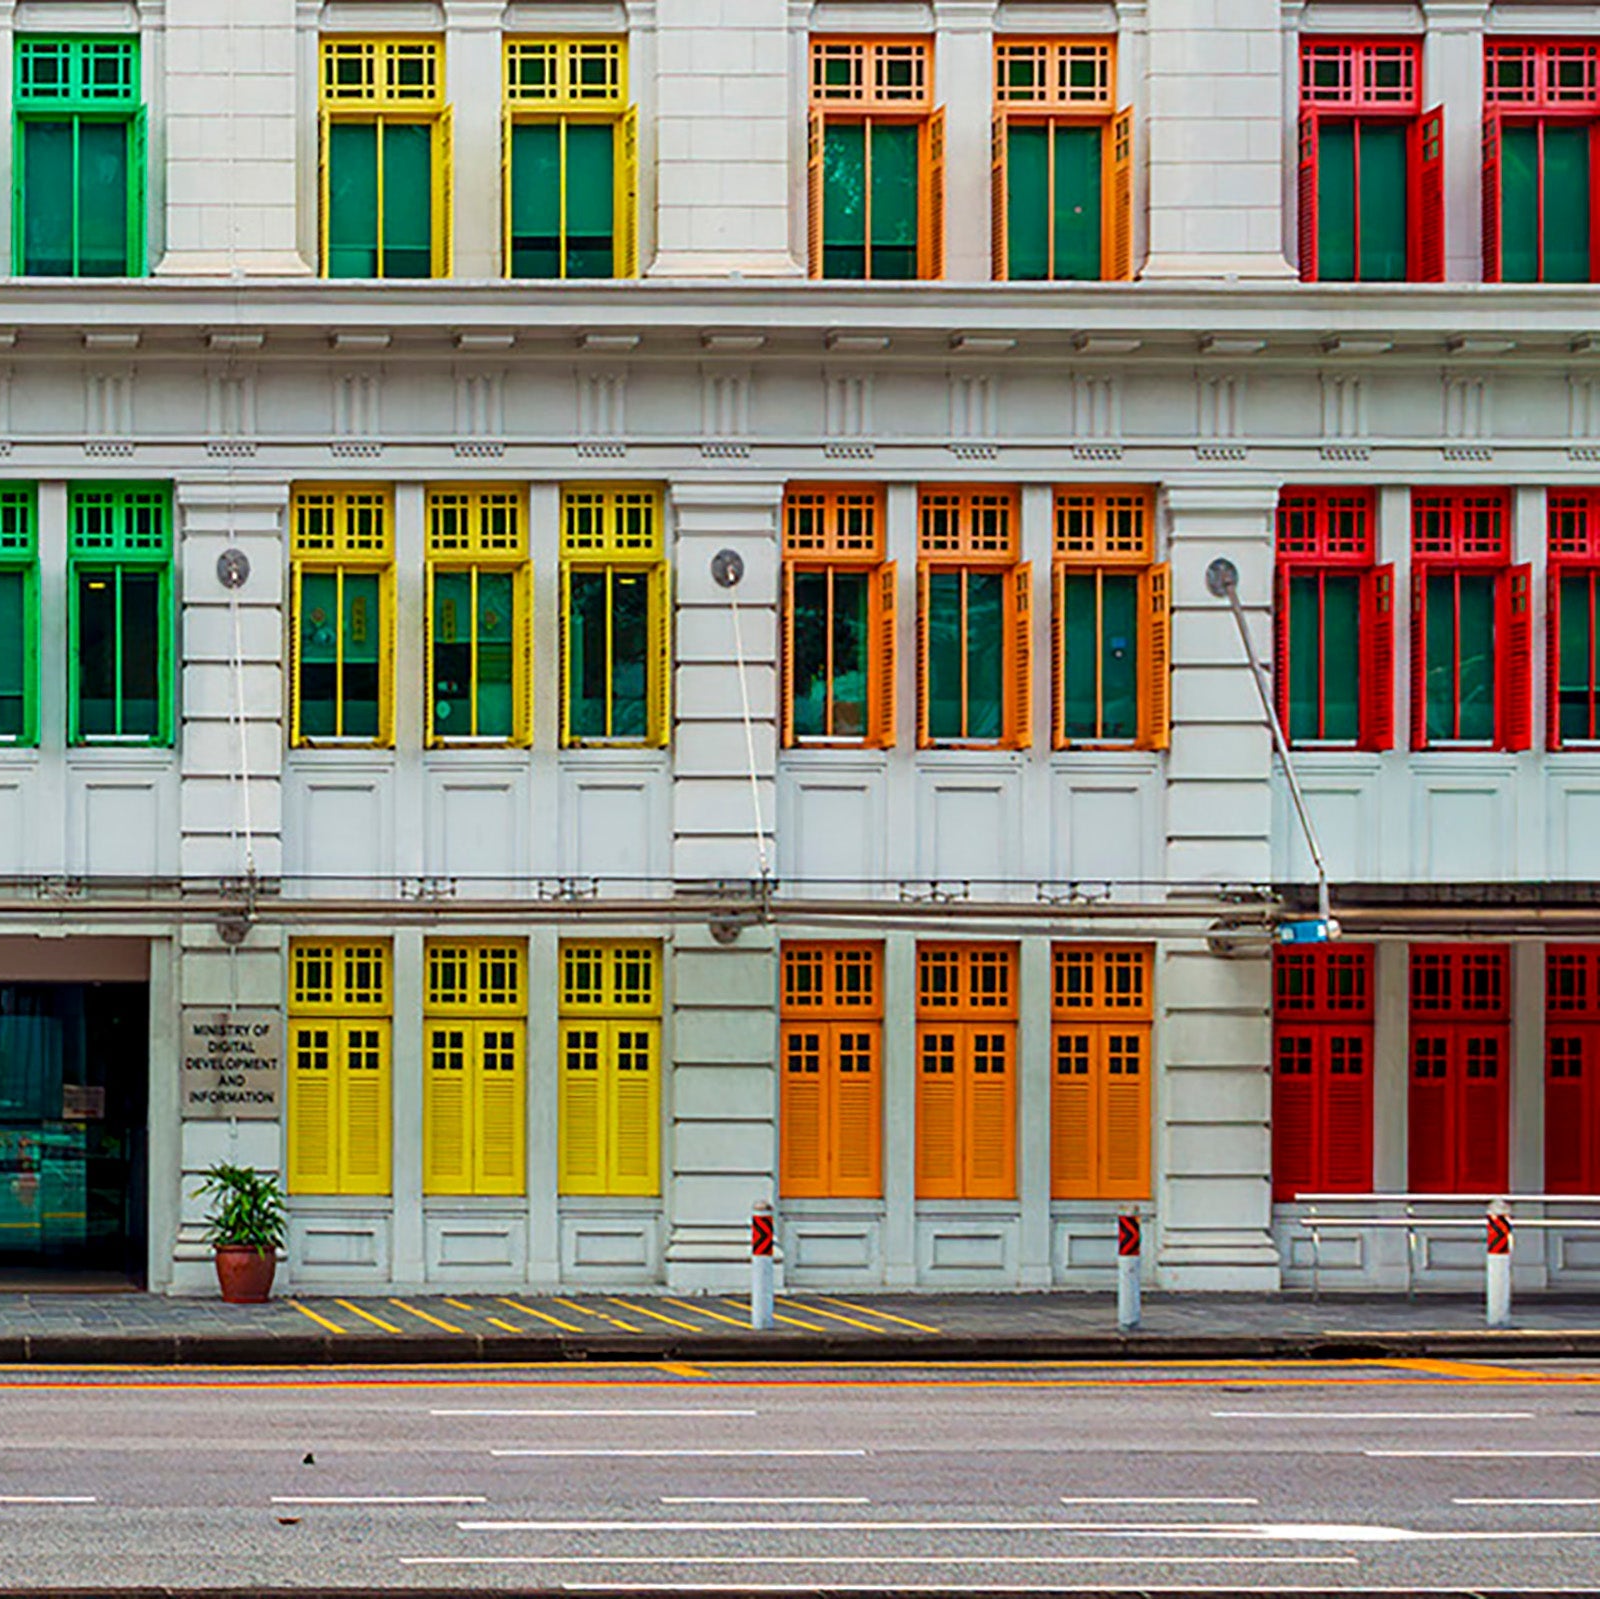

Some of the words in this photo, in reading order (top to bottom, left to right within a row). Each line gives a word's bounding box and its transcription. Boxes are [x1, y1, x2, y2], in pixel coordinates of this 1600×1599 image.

[193, 1024, 251, 1036] MINISTRY
[253, 1024, 270, 1037] OF
[208, 1040, 255, 1053] DIGITAL
[185, 1057, 278, 1070] DEVELOPMENT
[218, 1074, 246, 1087] AND
[188, 1090, 275, 1103] INFORMATION
